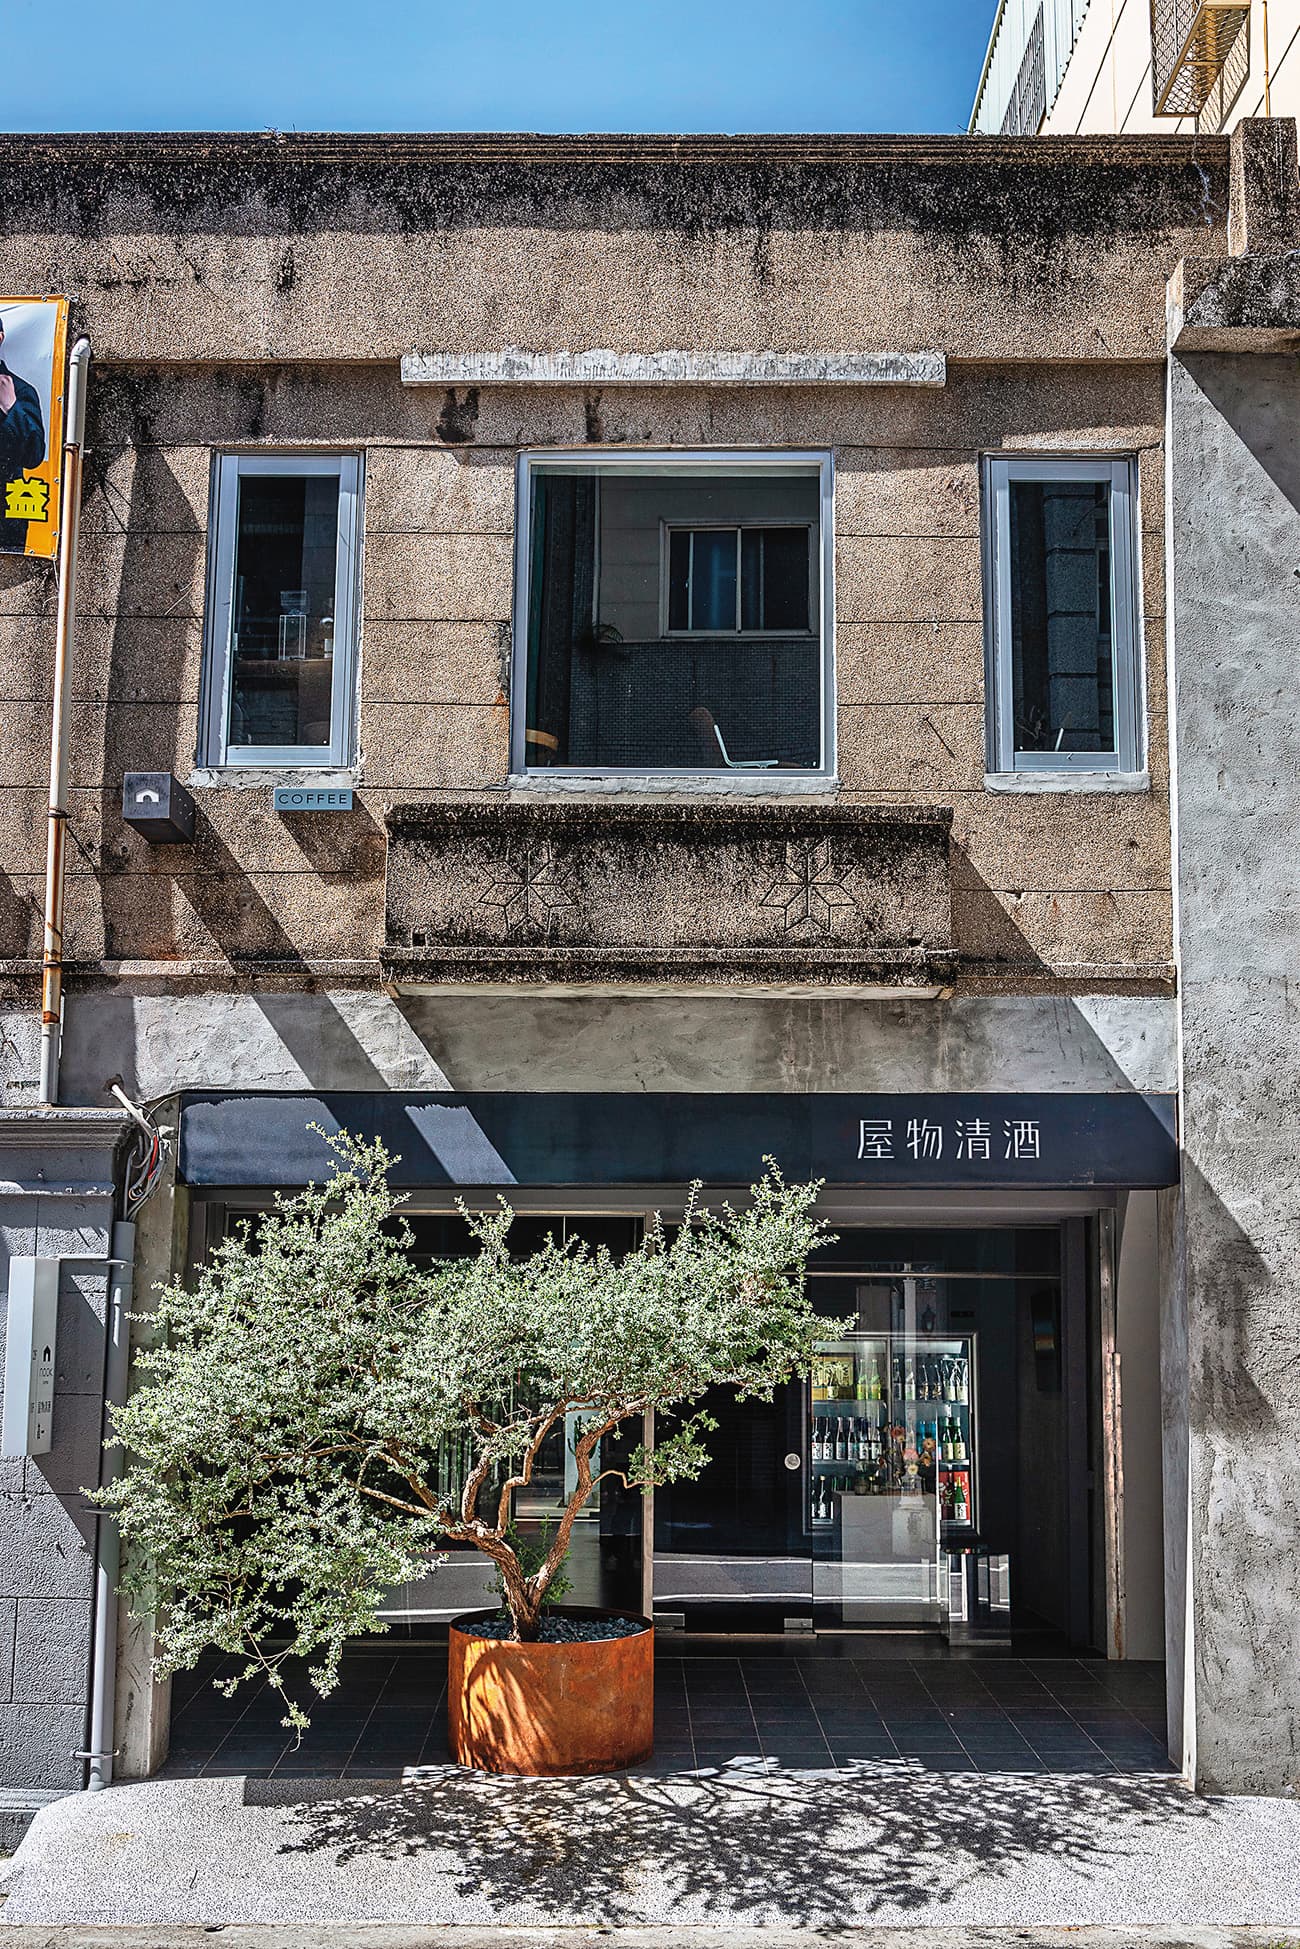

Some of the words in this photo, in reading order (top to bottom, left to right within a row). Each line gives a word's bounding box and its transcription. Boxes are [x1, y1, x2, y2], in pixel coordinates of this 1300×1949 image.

[5, 478, 48, 521] 益
[278, 793, 348, 805] COFFEE
[857, 1118, 1041, 1160] 屋物清酒
